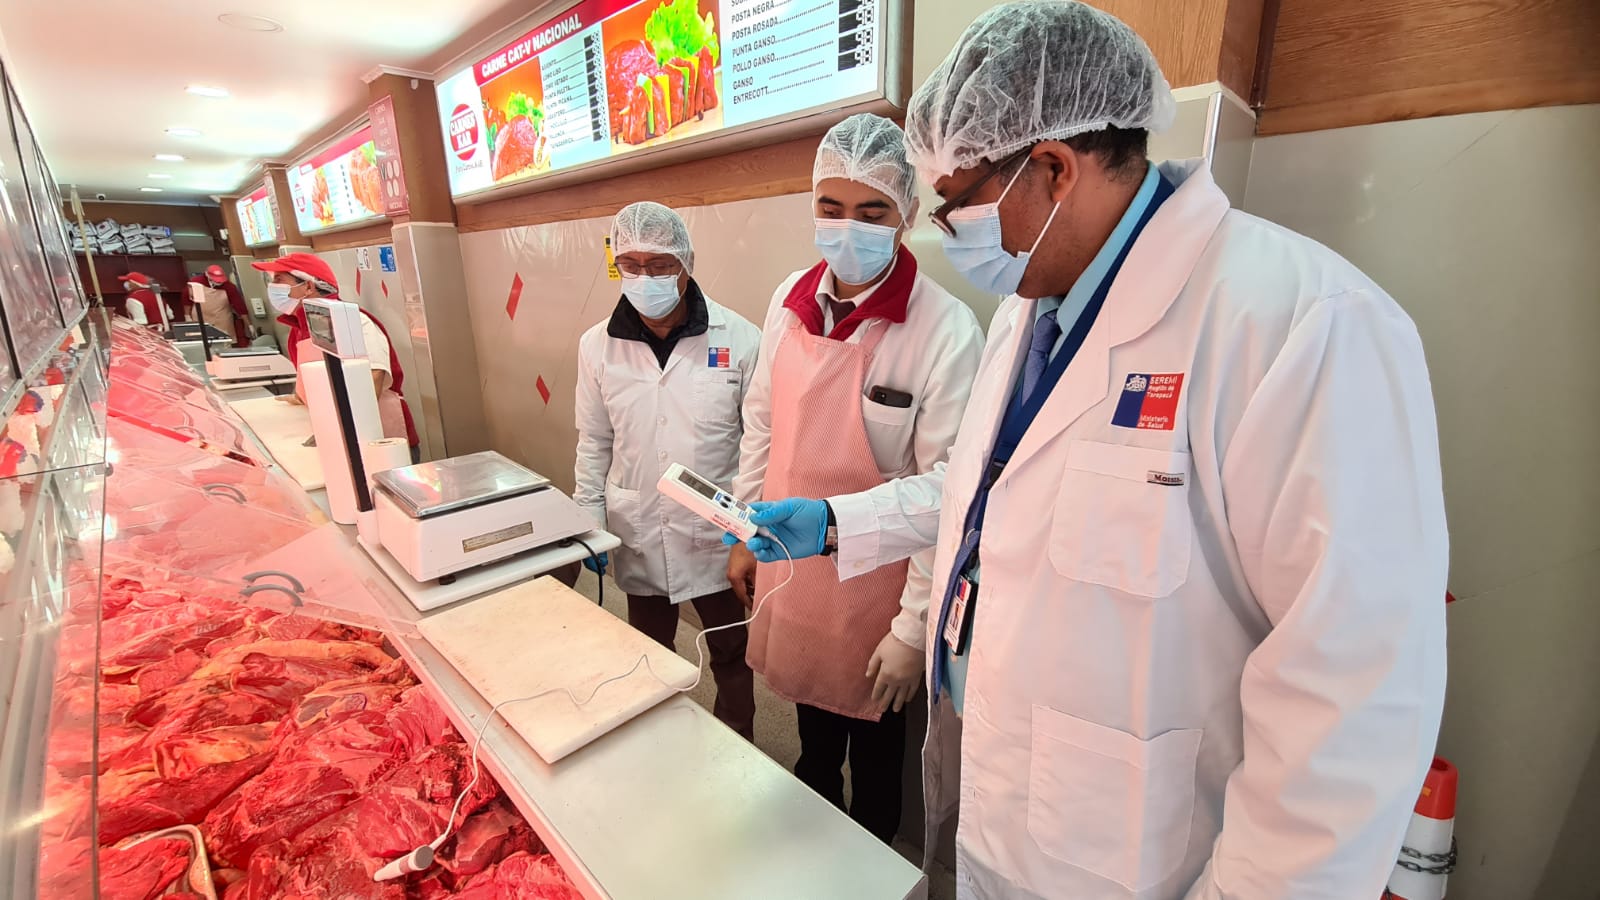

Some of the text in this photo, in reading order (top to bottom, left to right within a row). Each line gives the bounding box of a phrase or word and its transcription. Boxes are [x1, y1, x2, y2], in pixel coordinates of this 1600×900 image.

[731, 8, 751, 24] POSTA
[752, 0, 775, 16] NEGRA
[731, 16, 778, 40] POSTA ROSADA
[481, 13, 582, 78] CARNE CAT-V NACIONAL
[732, 35, 776, 58] PUNTA GANSO
[732, 53, 775, 73] POLLO GANSO
[733, 76, 753, 90] GANSO
[733, 86, 768, 104] ENTRECOTT
